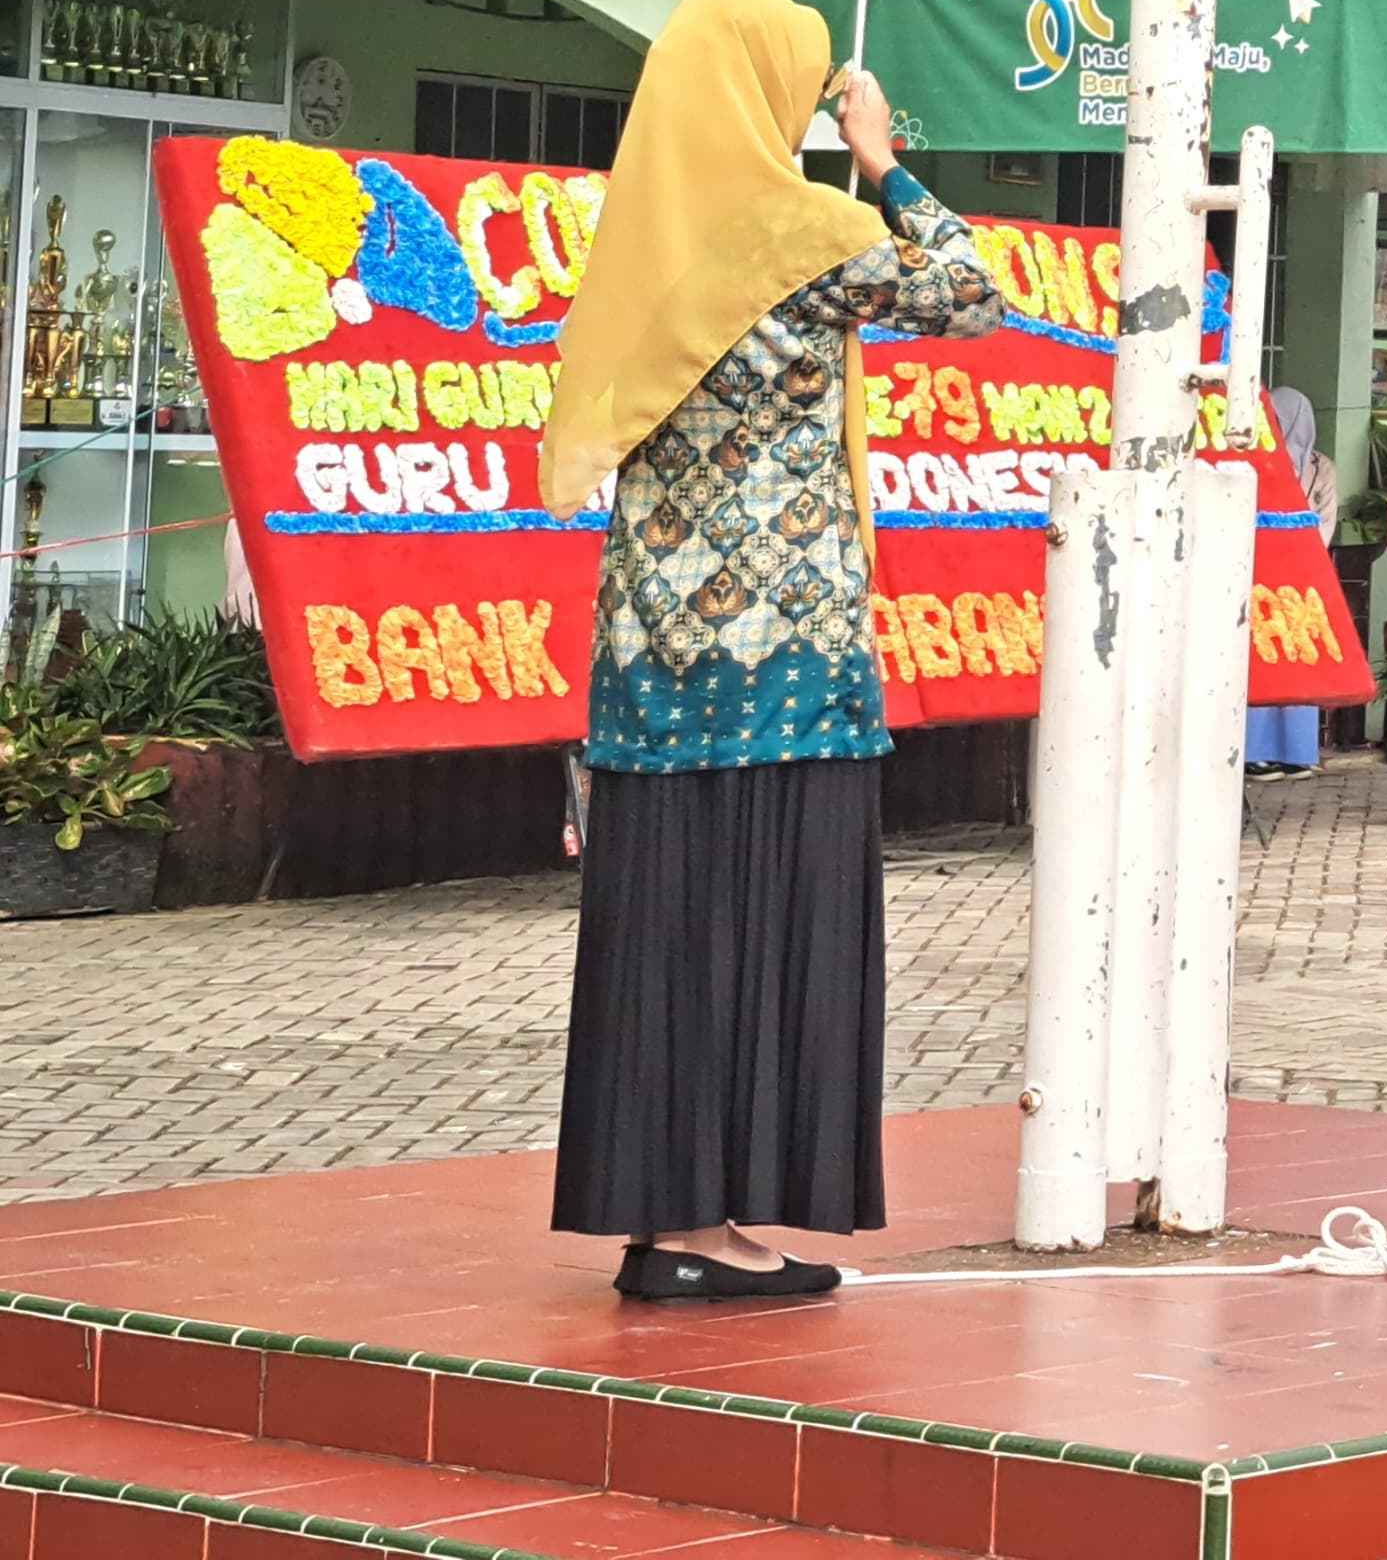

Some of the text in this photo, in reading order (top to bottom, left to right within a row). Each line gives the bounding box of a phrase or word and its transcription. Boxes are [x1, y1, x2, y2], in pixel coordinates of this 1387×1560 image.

[1080, 42, 1130, 68] Mad
[285, 359, 419, 432] HARI
[422, 360, 562, 430] GUR
[295, 441, 511, 514] GURU
[304, 599, 570, 708] BANK
[1250, 583, 1344, 666] AM
